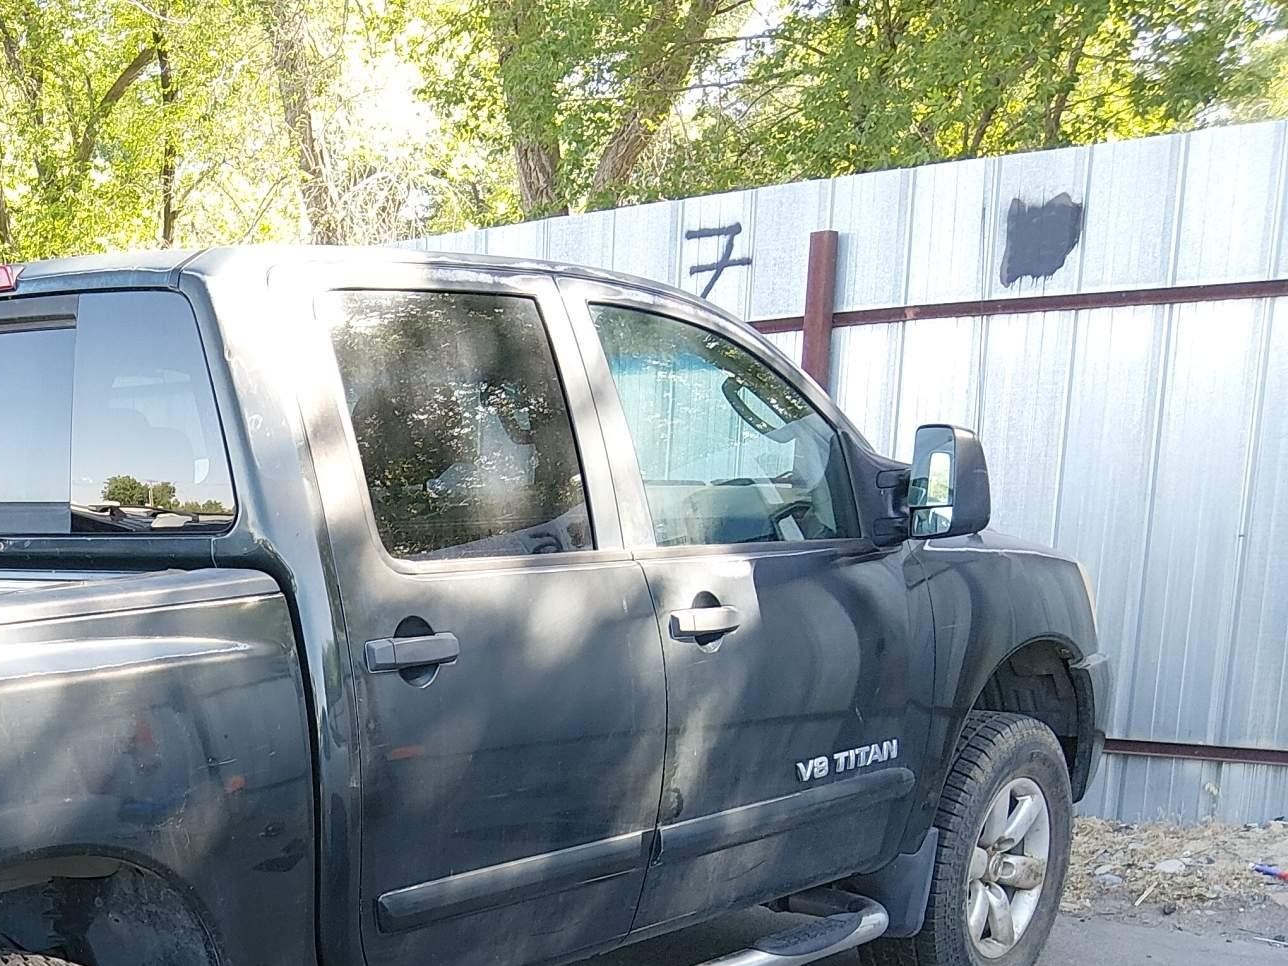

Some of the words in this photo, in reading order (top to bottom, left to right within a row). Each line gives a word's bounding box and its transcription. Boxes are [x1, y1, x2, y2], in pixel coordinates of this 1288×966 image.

[685, 222, 753, 299] 7
[796, 756, 829, 782] V8
[833, 739, 898, 773] TITAN
